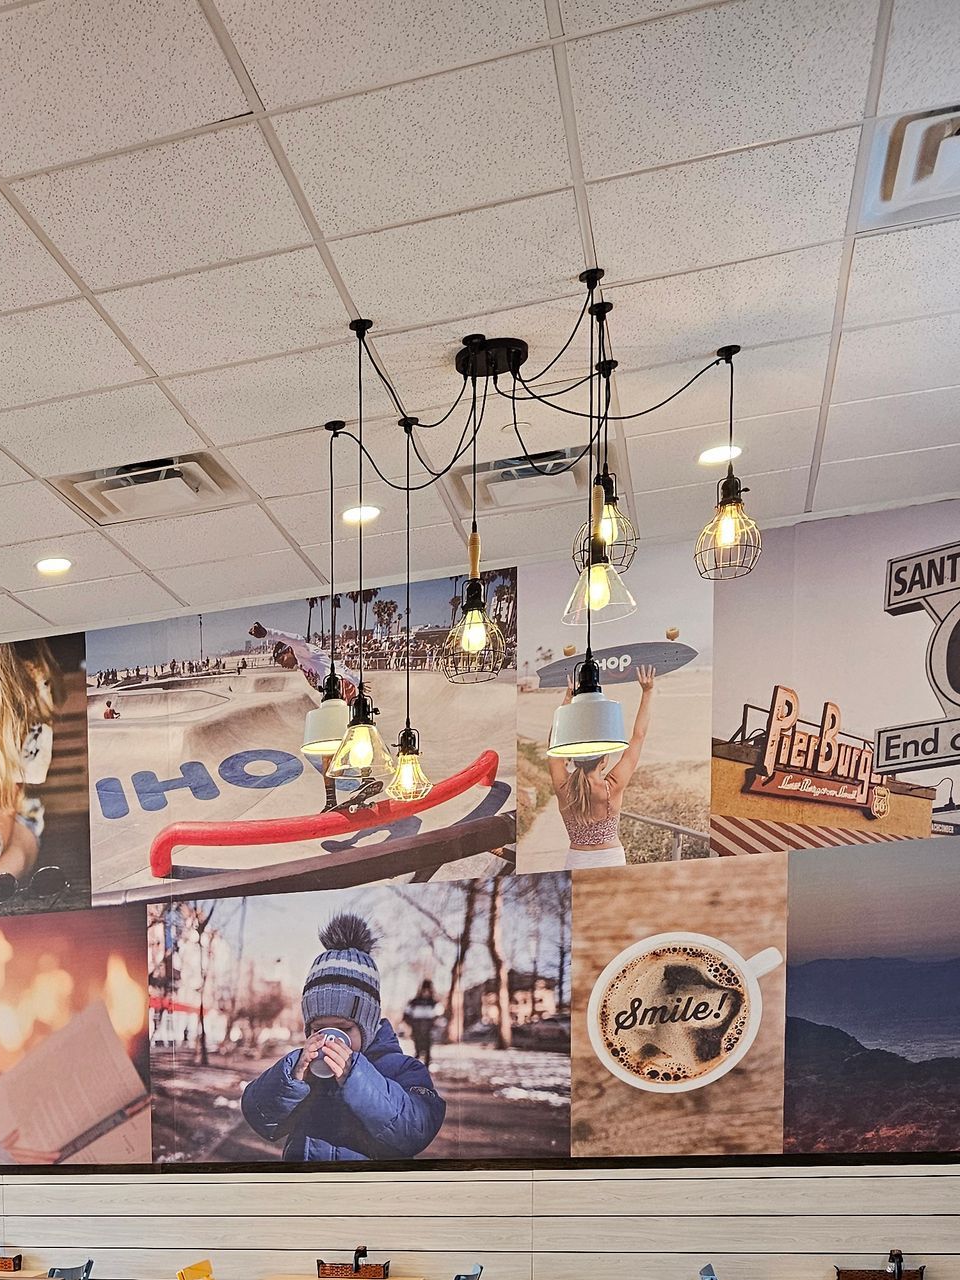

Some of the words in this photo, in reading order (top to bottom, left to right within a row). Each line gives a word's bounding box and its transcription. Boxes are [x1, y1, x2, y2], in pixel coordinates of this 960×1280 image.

[763, 684, 887, 805] PierBurg
[884, 728, 939, 761] End
[614, 992, 729, 1036] Smile!
